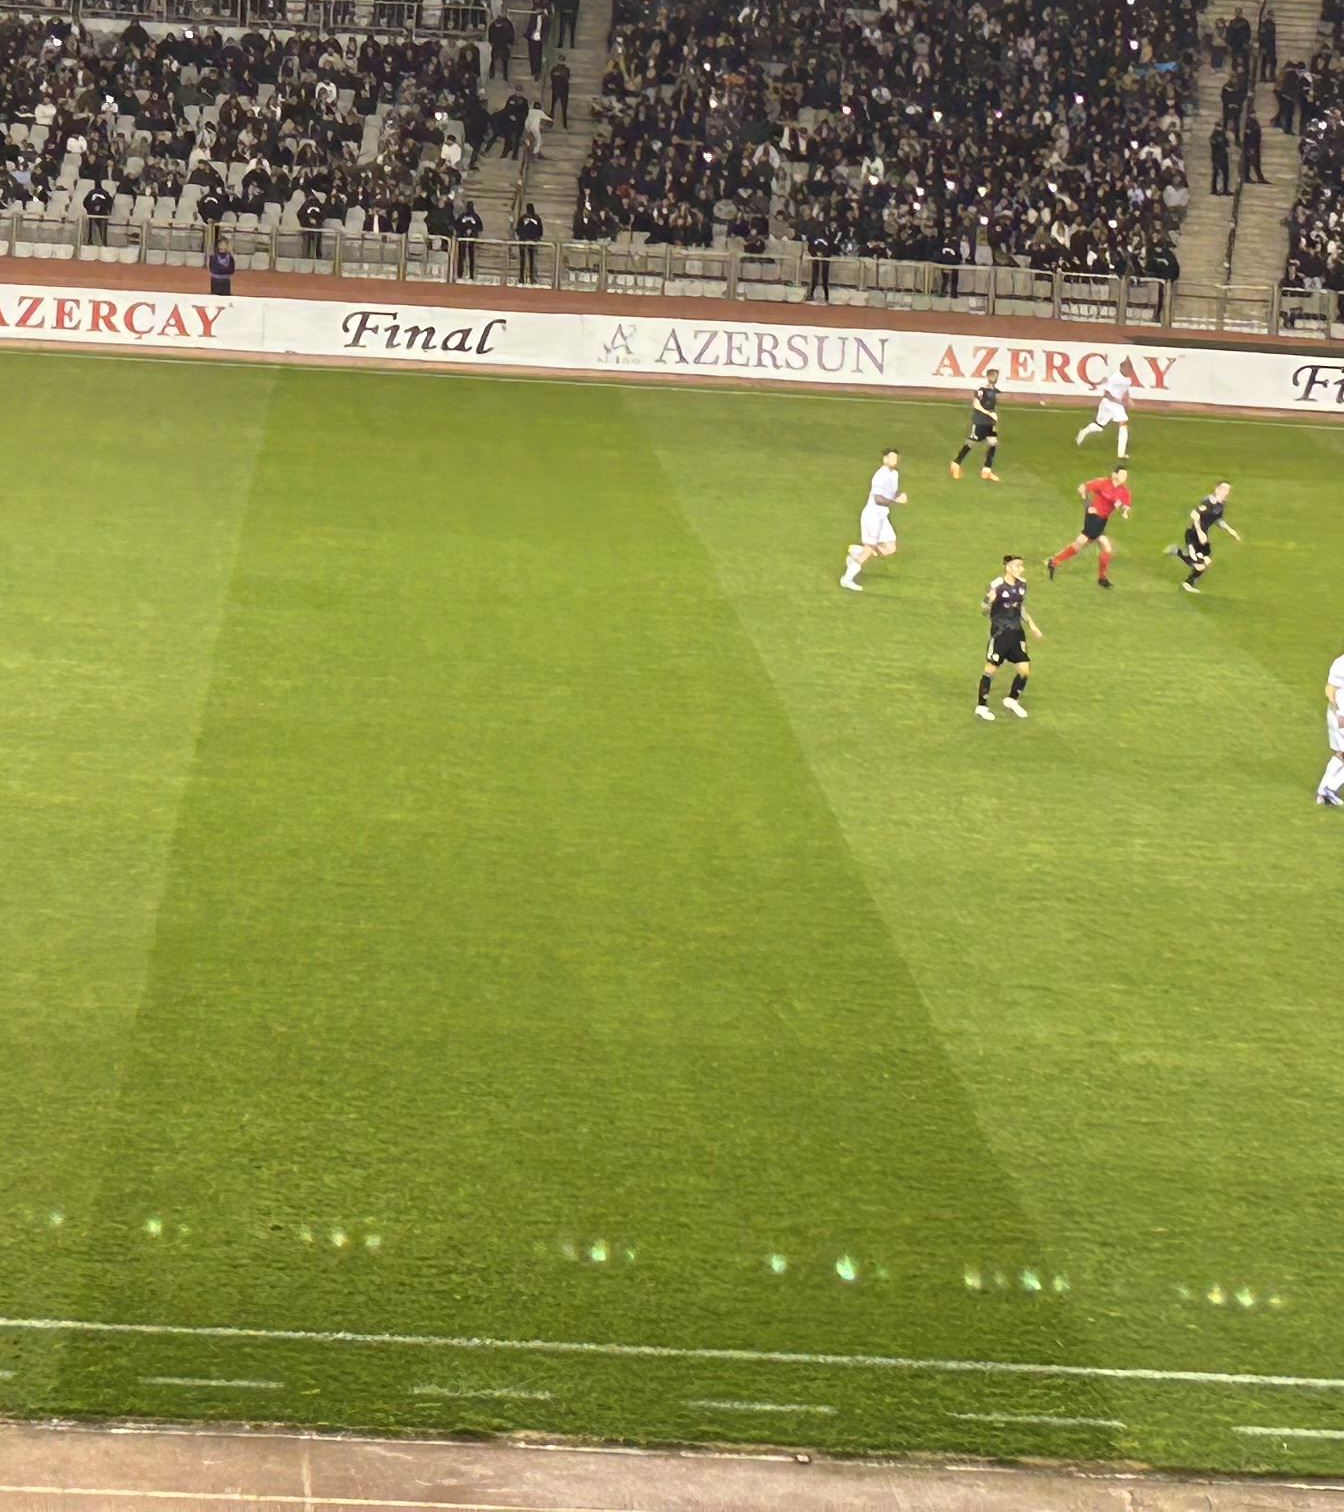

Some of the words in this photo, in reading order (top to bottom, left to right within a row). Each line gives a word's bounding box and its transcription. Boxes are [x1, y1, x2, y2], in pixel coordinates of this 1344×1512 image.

[341, 310, 507, 355] Final
[654, 327, 889, 375] AZERSUN
[931, 344, 1177, 392] AZERÇAY
